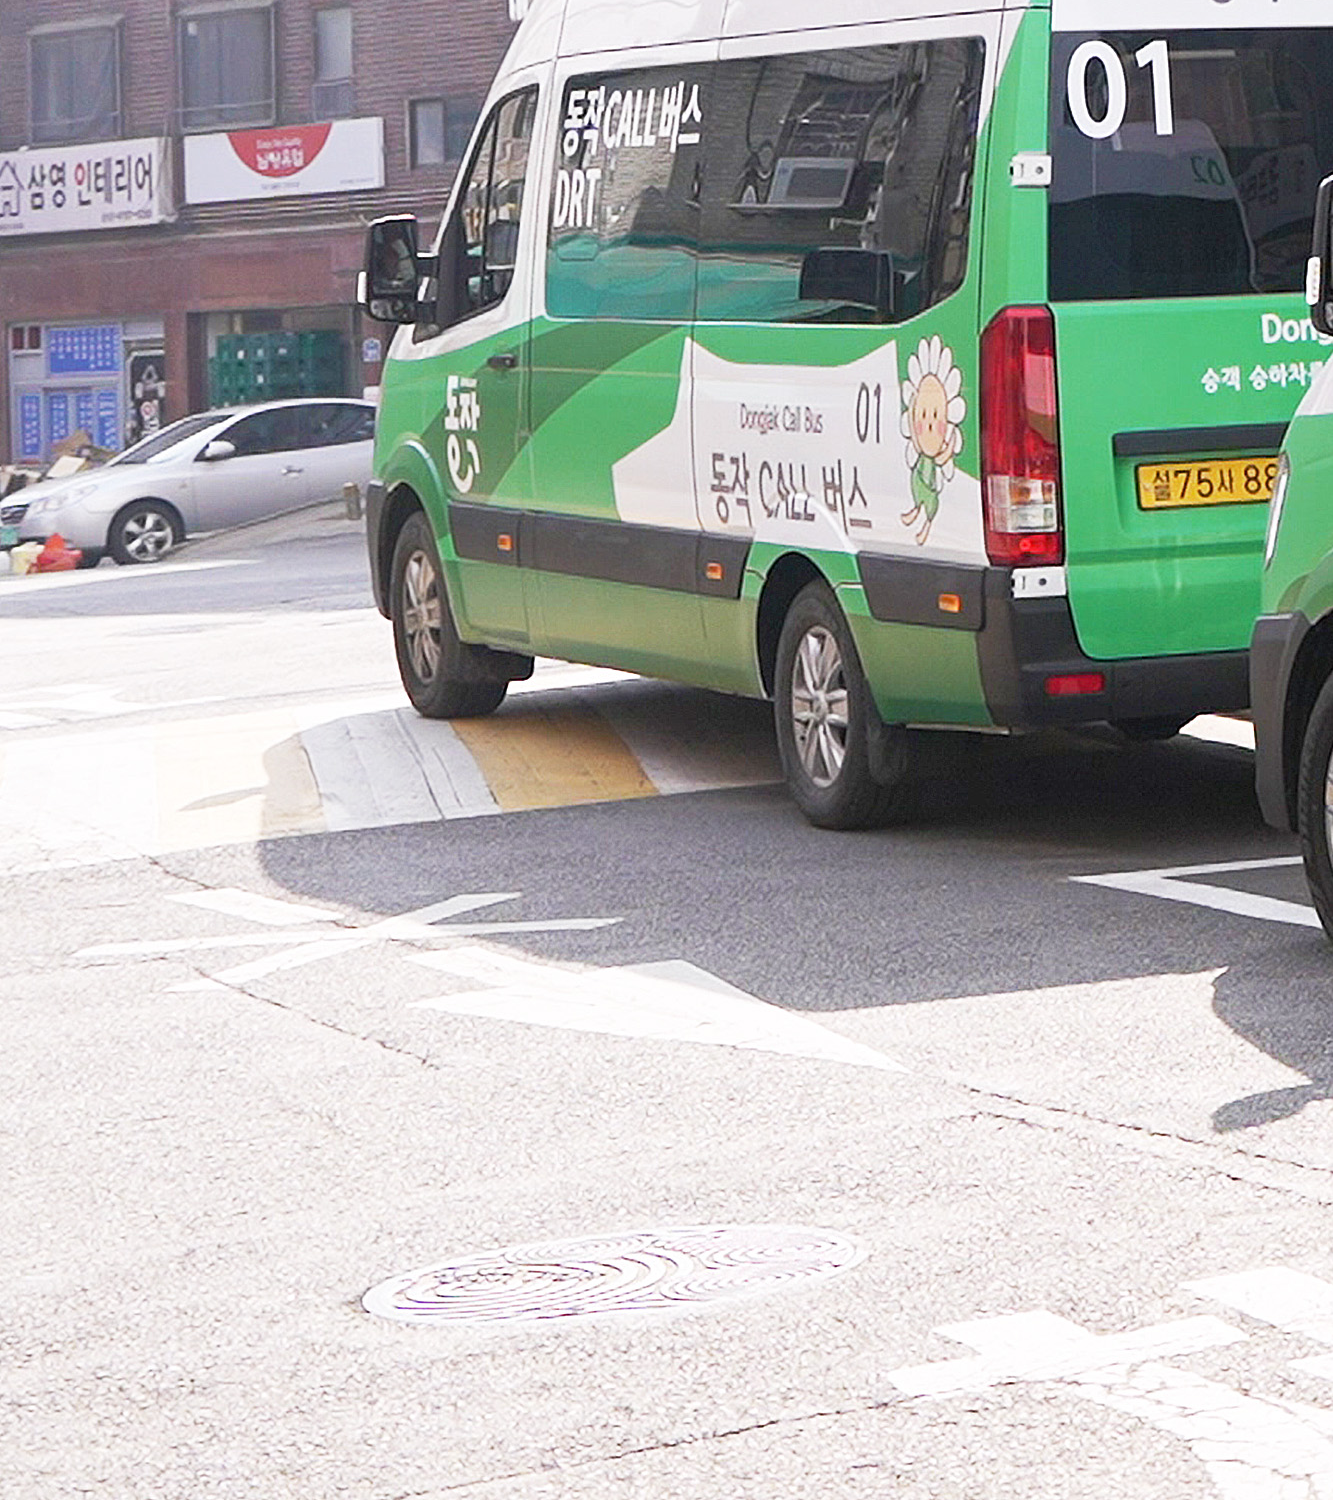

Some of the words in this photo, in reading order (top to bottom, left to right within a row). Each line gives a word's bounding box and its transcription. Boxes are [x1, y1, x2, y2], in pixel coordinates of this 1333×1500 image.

[658, 81, 702, 153] 버스
[1067, 40, 1173, 139] 01
[28, 162, 67, 211] 삼영
[74, 152, 153, 207] 인테리어
[553, 169, 602, 227] DRT
[1201, 365, 1242, 394] 승객
[857, 382, 881, 444] 01
[711, 452, 753, 531] 동작
[759, 460, 815, 521] CALL
[823, 458, 872, 536] 버스
